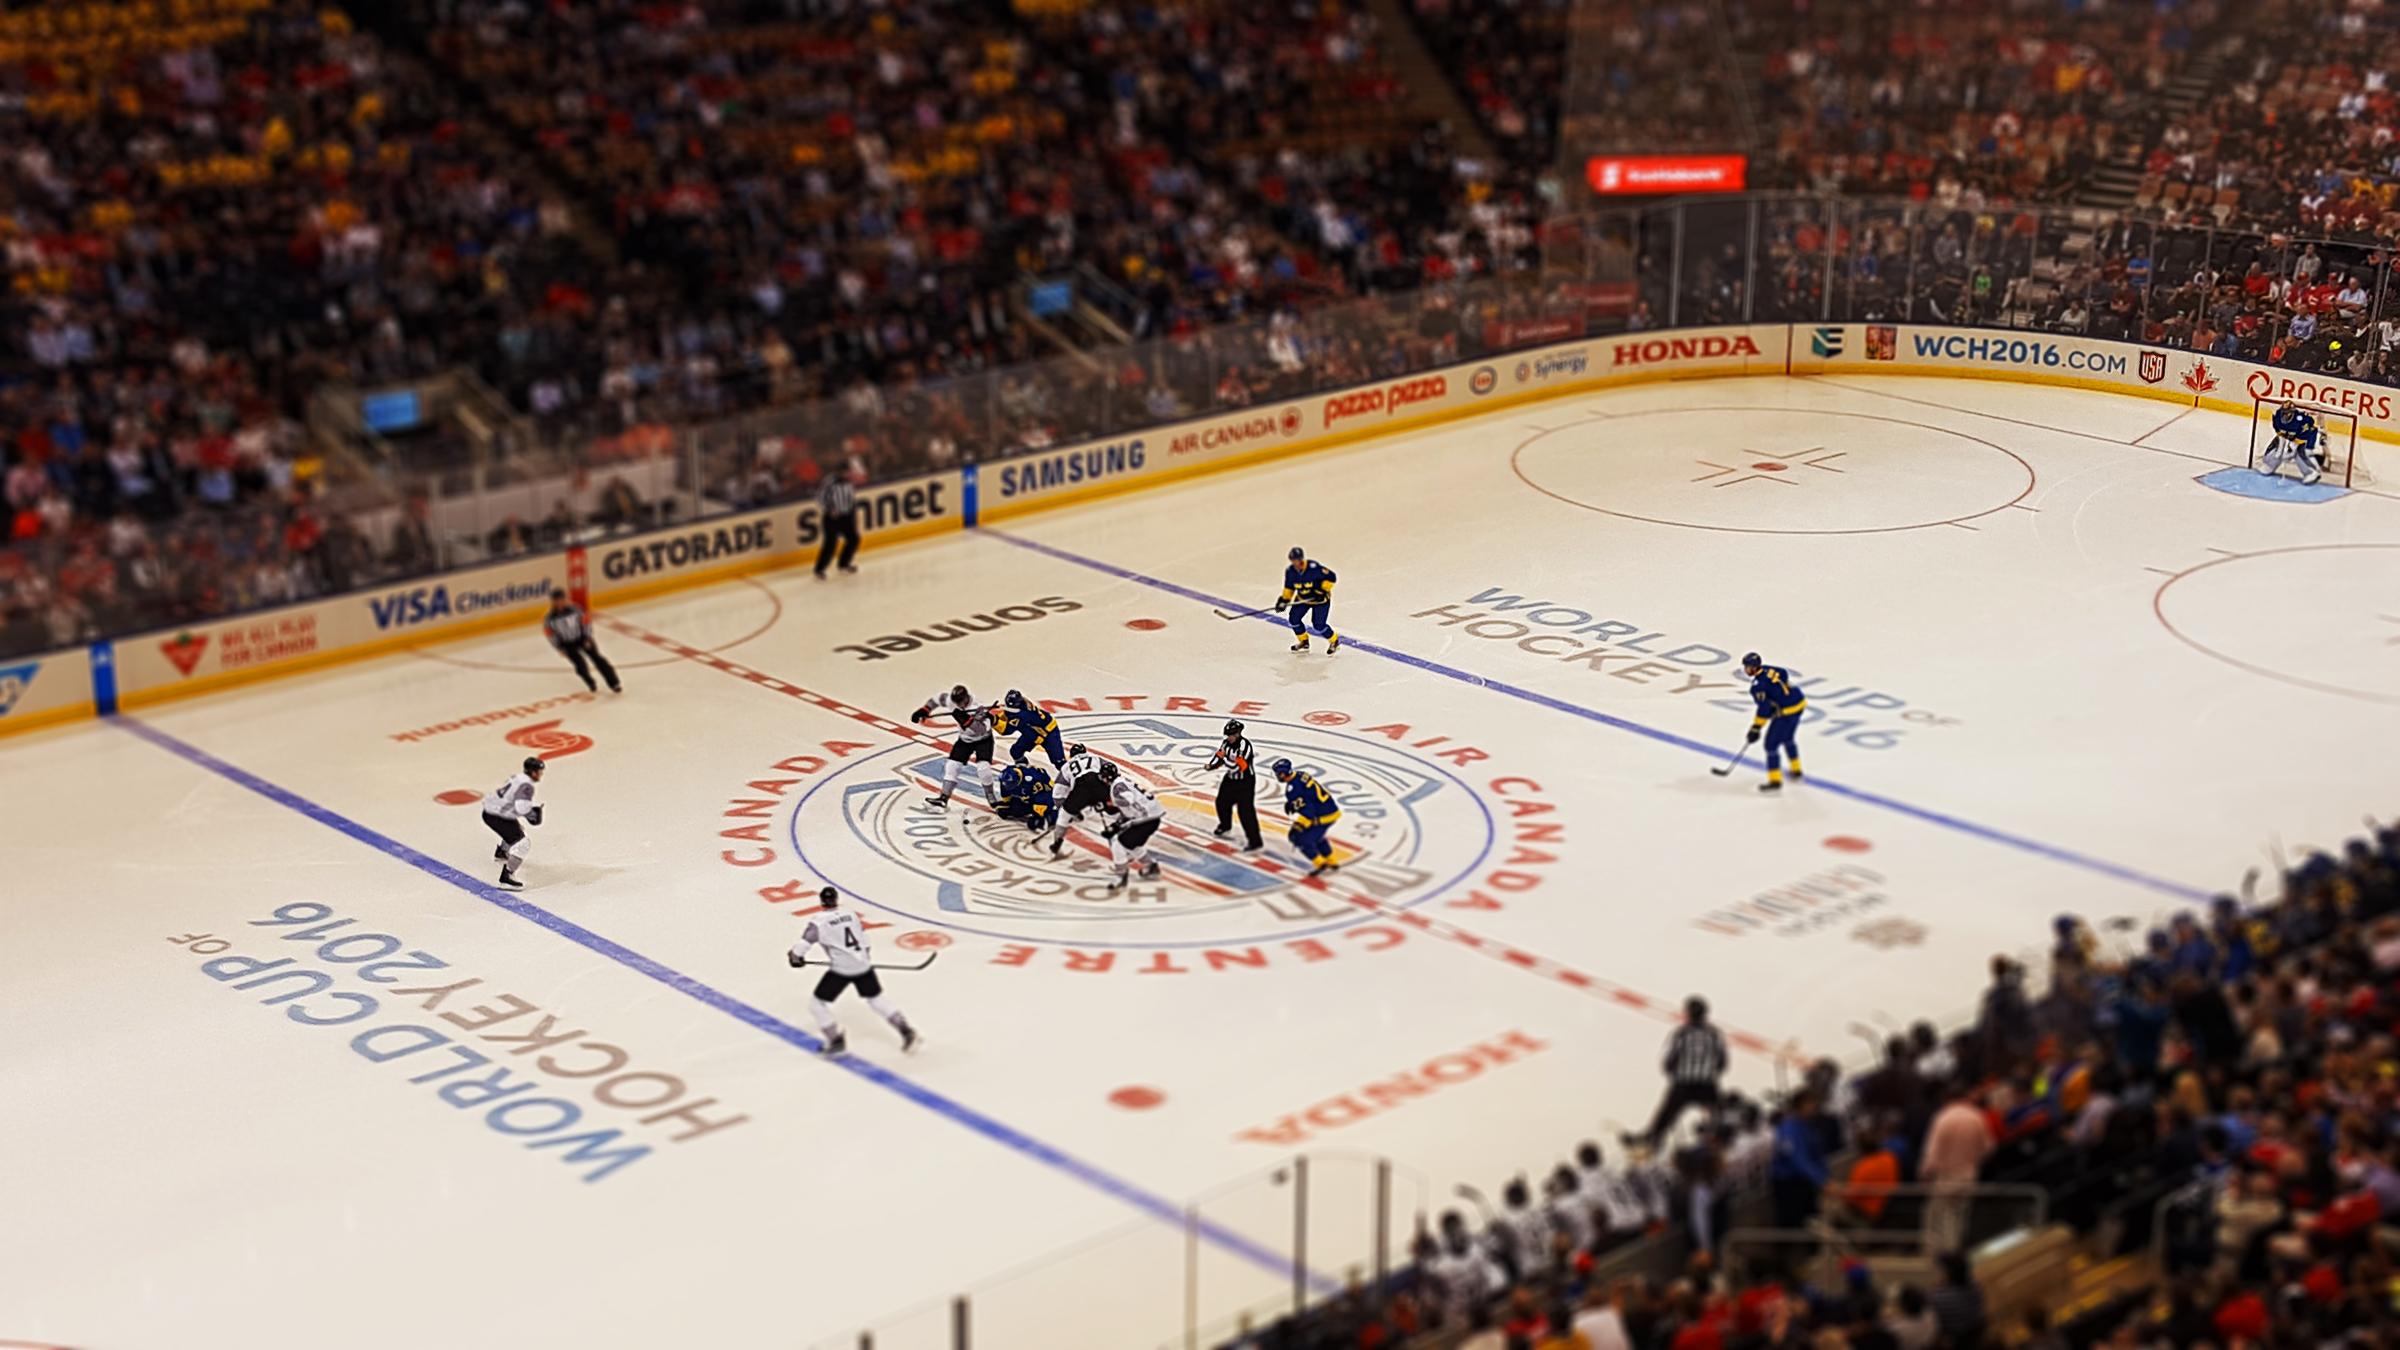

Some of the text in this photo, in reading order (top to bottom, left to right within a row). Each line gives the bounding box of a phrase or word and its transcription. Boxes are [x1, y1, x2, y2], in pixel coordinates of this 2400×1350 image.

[1612, 335, 1761, 366] HONDA
[1913, 333, 2126, 375] WCH2016.COM
[2141, 352, 2163, 379] USA
[1324, 375, 1446, 428] pizza pizza
[2280, 379, 2391, 420] ROGERS
[1169, 417, 1276, 455] AIR CANADA
[1000, 441, 1146, 497] SAMSUNG
[797, 481, 945, 544] snnet
[602, 520, 773, 581] GATORADE
[371, 586, 451, 630] VISA
[833, 596, 1083, 661] sonnet
[1465, 587, 1731, 666] WORLD
[1410, 604, 1736, 695] HOCKEY
[389, 692, 596, 742] Scotiabank
[1069, 757, 1092, 777] 97
[1120, 743, 1327, 777] WOLD
[720, 739, 875, 867] CANADA
[990, 721, 1566, 973] AIR CANADA CENTRE
[925, 852, 1167, 903] HOCKEY
[845, 926, 861, 951] 4
[248, 901, 751, 1143] HOCKEY 2016
[166, 931, 654, 1184] WORLD CUP OF
[1231, 1028, 1549, 1145] HONDA
